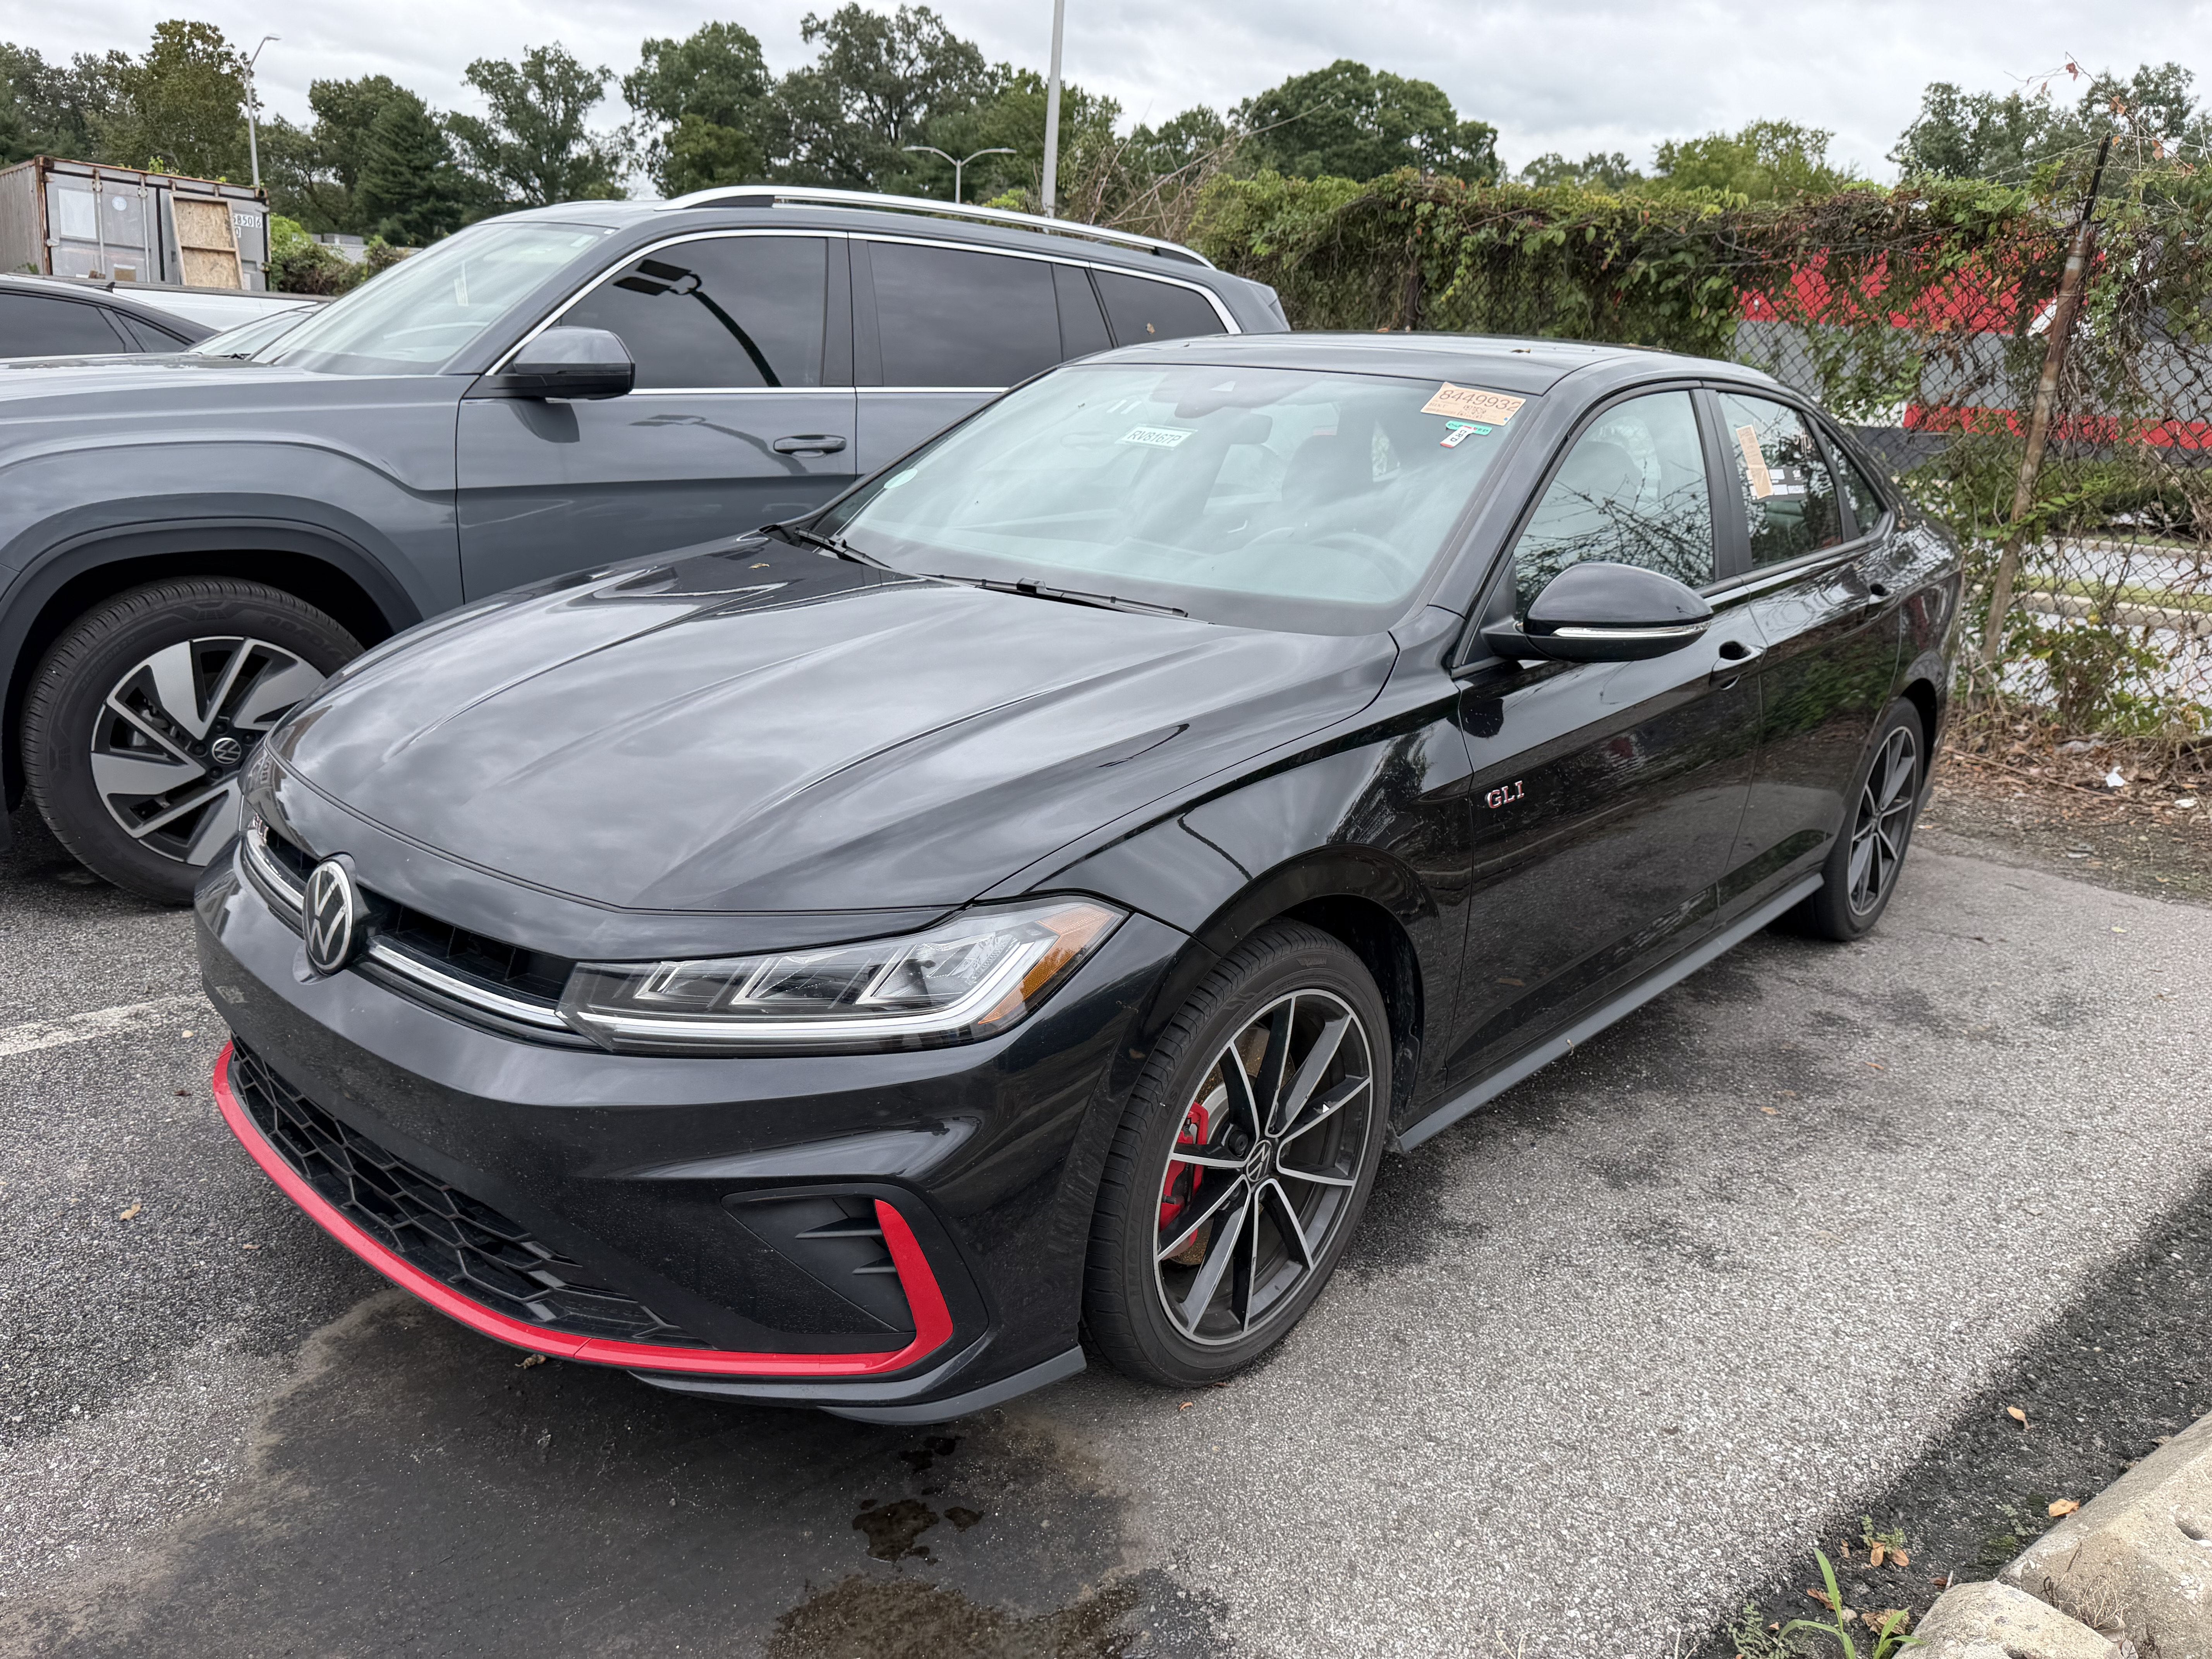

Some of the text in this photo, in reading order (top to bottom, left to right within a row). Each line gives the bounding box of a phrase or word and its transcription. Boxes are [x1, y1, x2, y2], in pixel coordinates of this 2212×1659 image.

[1439, 390, 1522, 412] 8449932
[1127, 430, 1182, 444] RV8167P
[1487, 780, 1525, 809] GLI
